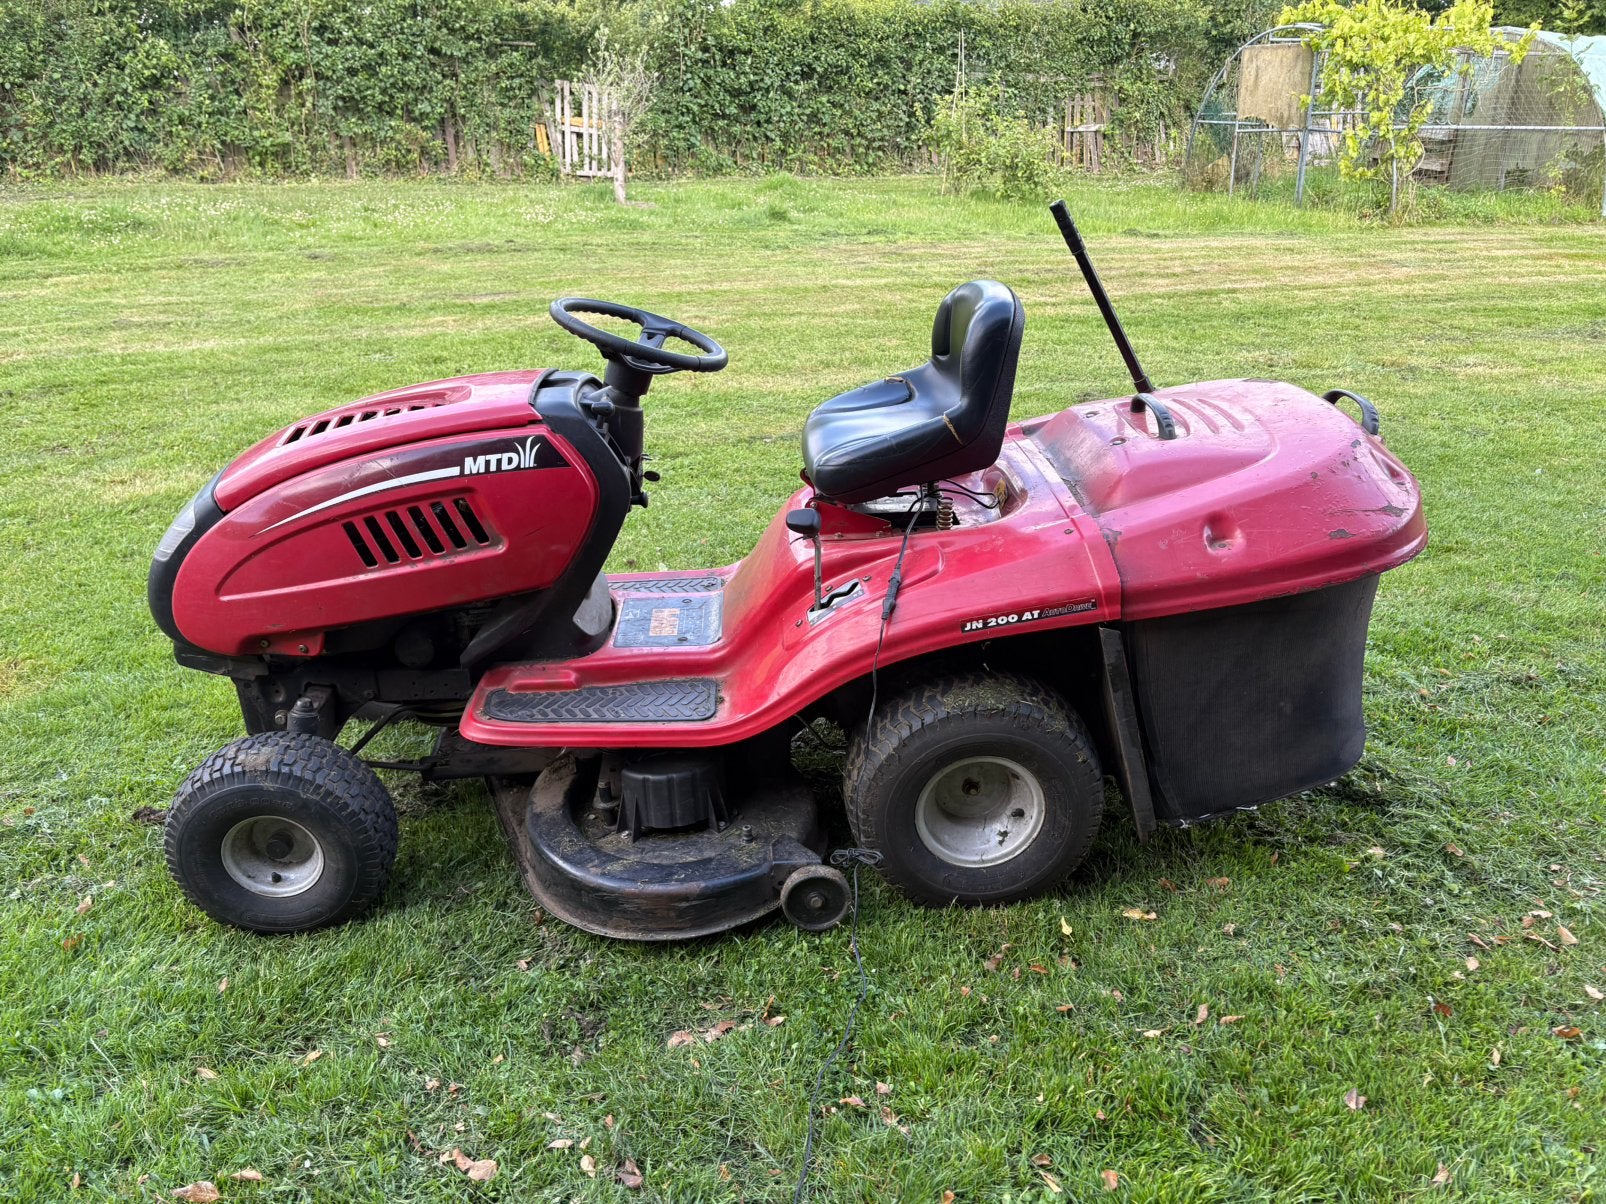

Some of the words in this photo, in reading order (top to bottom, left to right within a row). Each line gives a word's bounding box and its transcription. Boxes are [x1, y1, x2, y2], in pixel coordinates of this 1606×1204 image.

[464, 452, 519, 475] MTD
[964, 620, 983, 631] JN
[986, 614, 1018, 627] 200
[1021, 610, 1040, 620] AT
